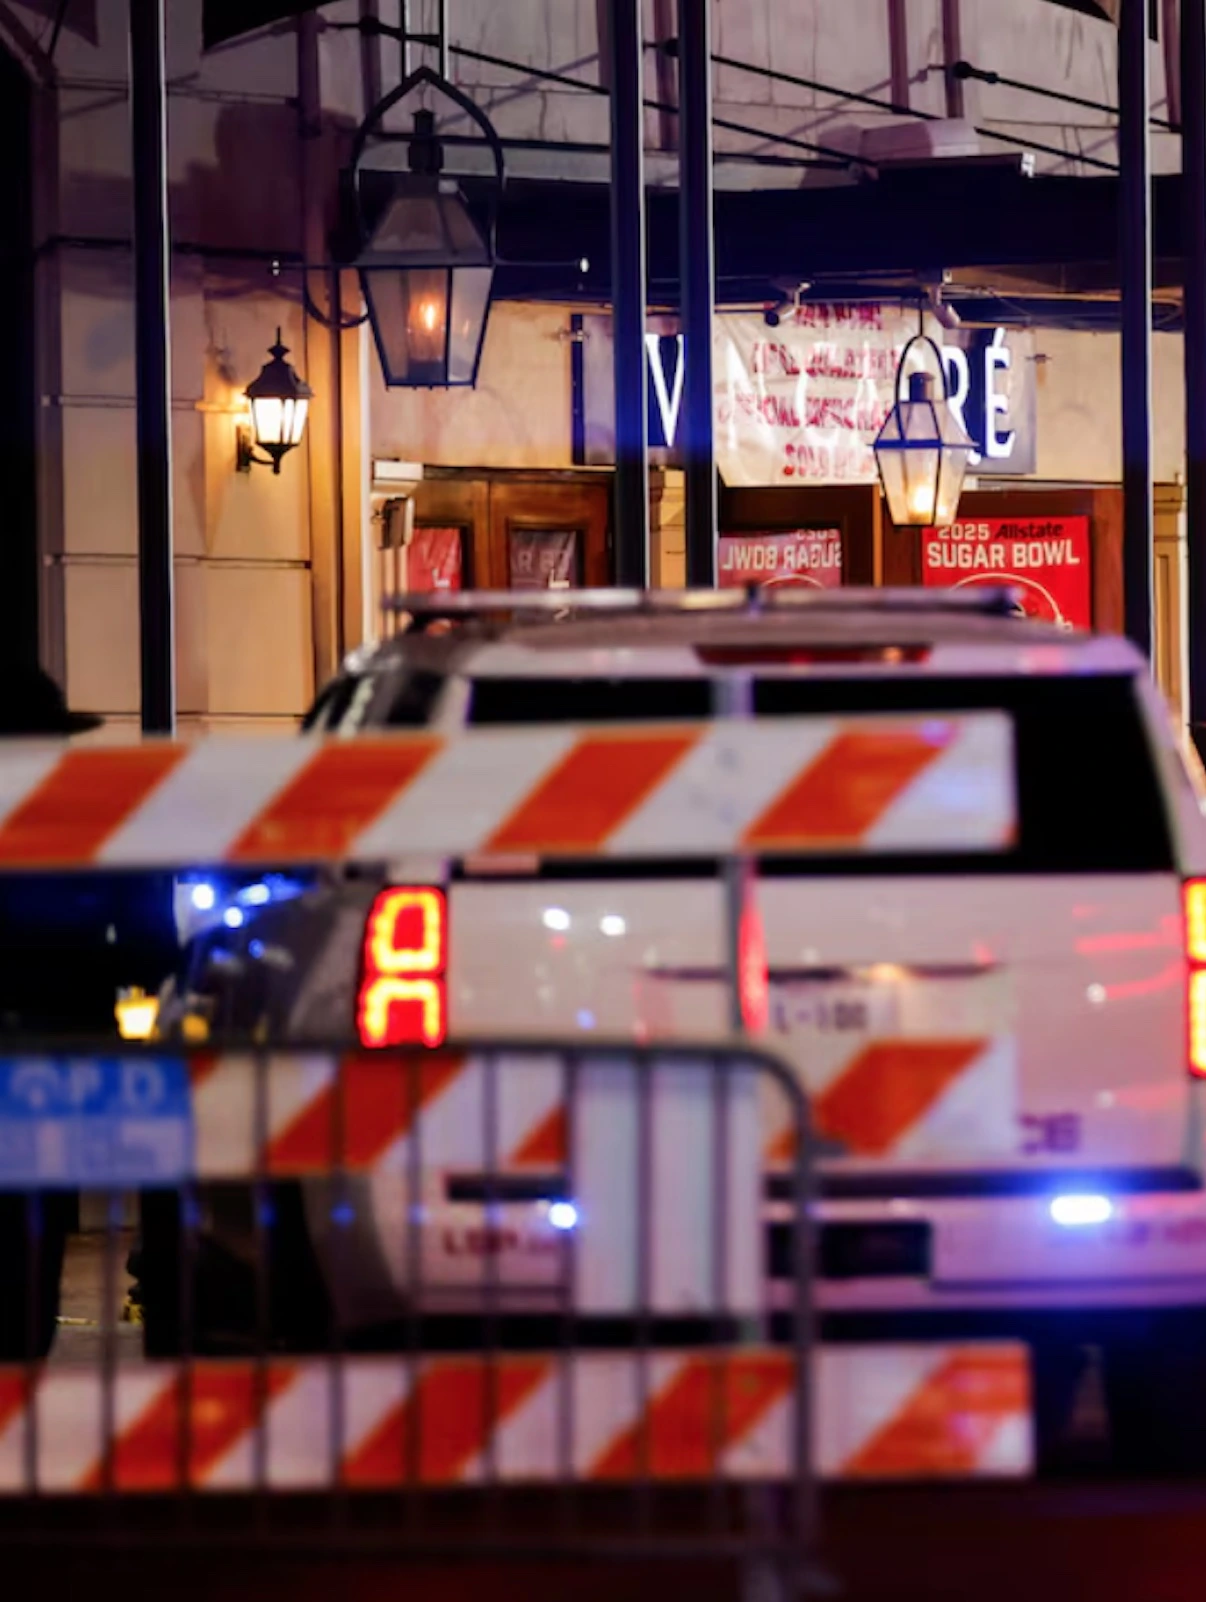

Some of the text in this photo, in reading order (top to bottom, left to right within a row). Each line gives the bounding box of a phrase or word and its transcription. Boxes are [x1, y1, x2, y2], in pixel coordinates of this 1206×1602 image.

[938, 522, 1074, 541] 2025 Allstate
[927, 538, 1081, 569] SUGAR BOWL
